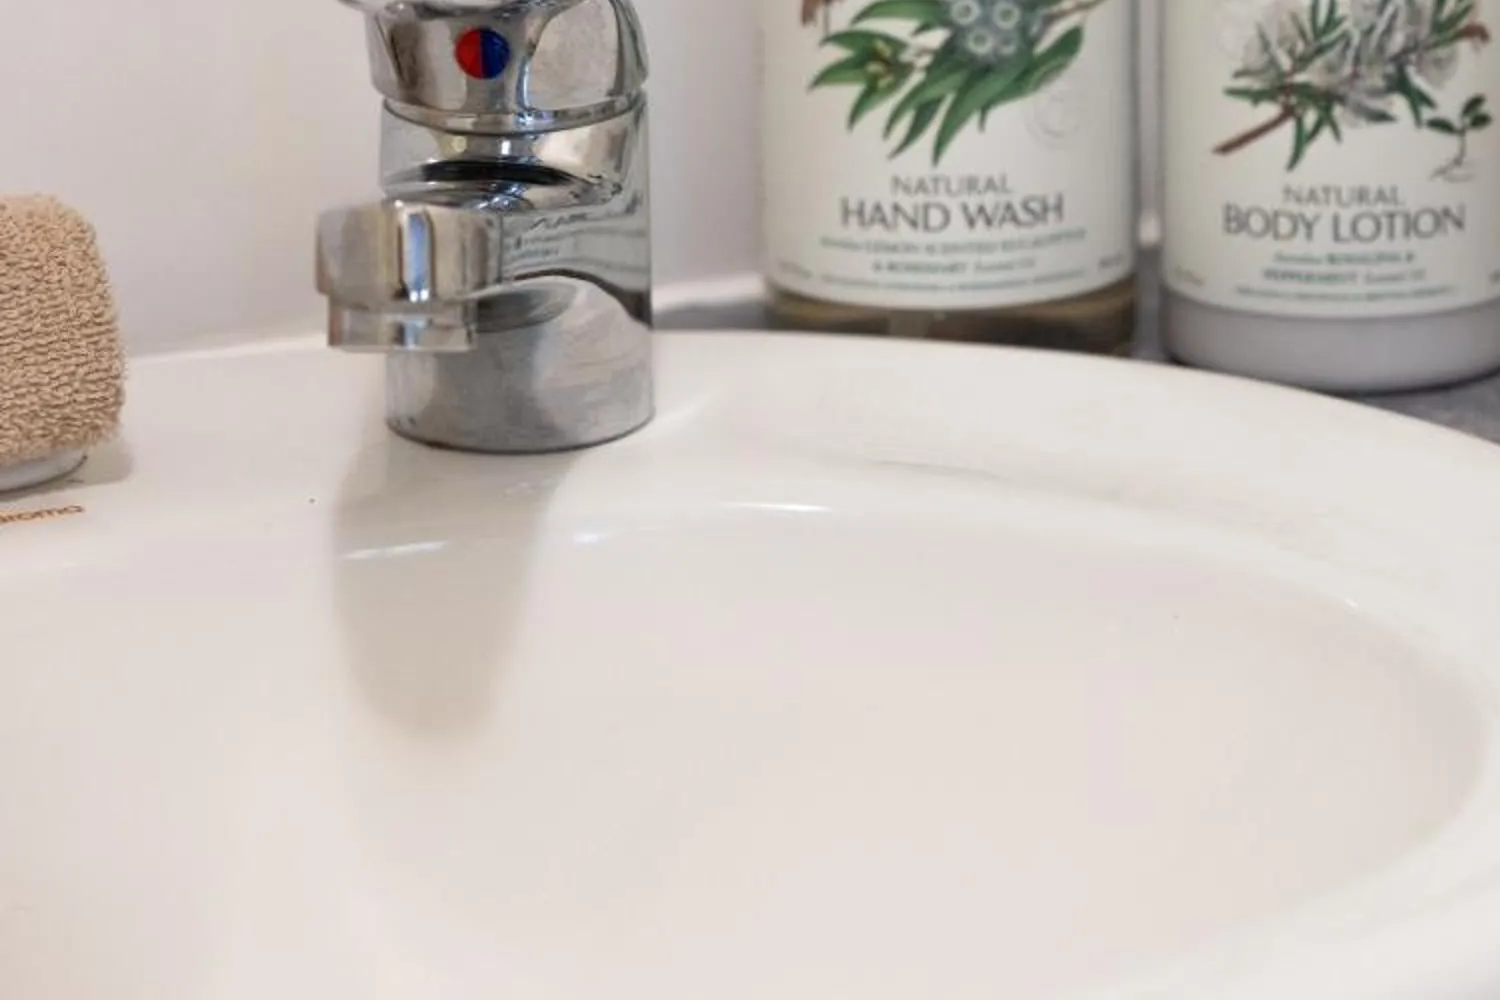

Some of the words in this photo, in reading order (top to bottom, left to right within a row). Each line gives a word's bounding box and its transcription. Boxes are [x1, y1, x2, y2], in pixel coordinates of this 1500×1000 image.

[890, 173, 1014, 198] NATURAL
[1282, 184, 1406, 208] NATURAL
[841, 195, 951, 233] HAND
[961, 190, 1064, 231] WASH
[1223, 200, 1322, 242] BODY
[1331, 201, 1467, 244] LOTION
